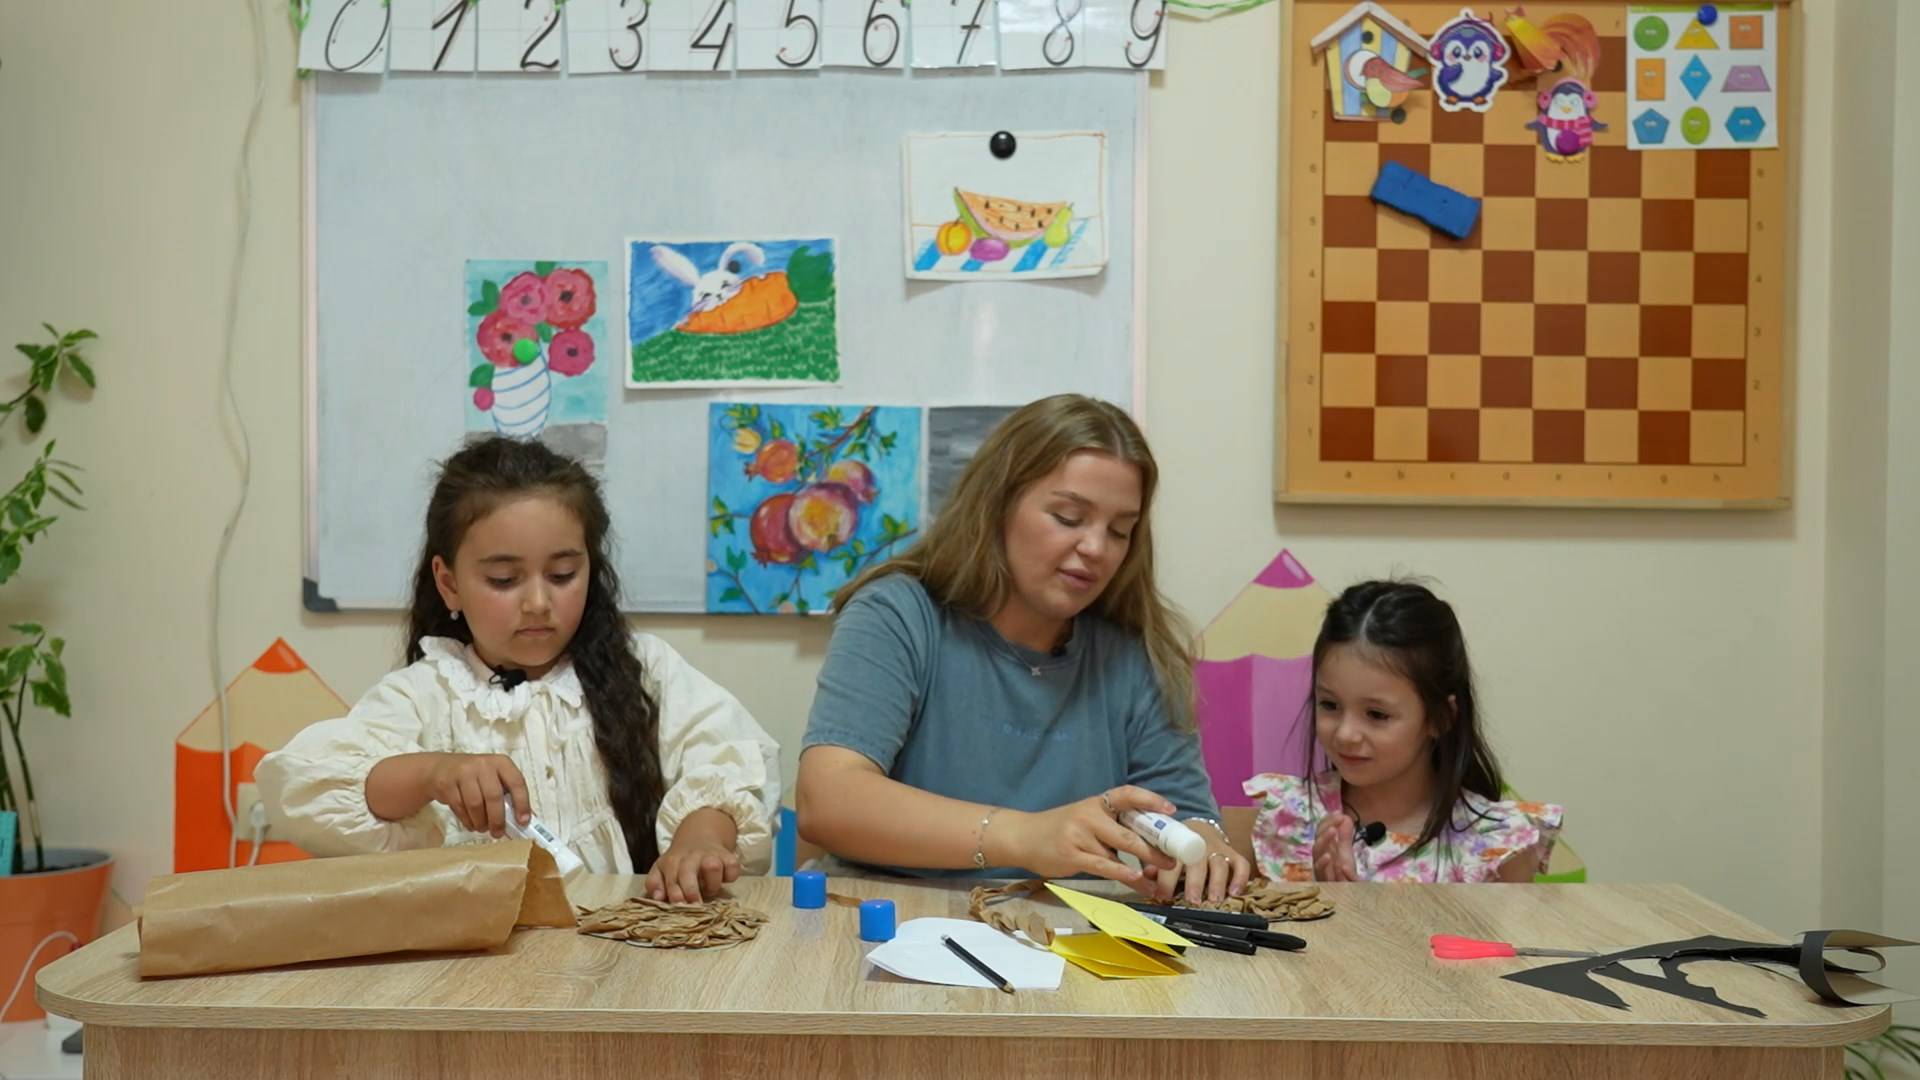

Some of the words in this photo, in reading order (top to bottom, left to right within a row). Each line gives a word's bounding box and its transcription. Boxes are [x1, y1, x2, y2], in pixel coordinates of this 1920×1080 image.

[325, 0, 390, 71] 0
[431, 0, 470, 71] 1
[519, 0, 560, 69] 2
[608, 0, 649, 70] 3
[690, 0, 733, 70] 4
[775, 0, 818, 67] 5
[863, 0, 900, 66] 6
[952, 0, 985, 64] 7
[1042, 0, 1082, 66] 8
[1125, 0, 1168, 67] 9
